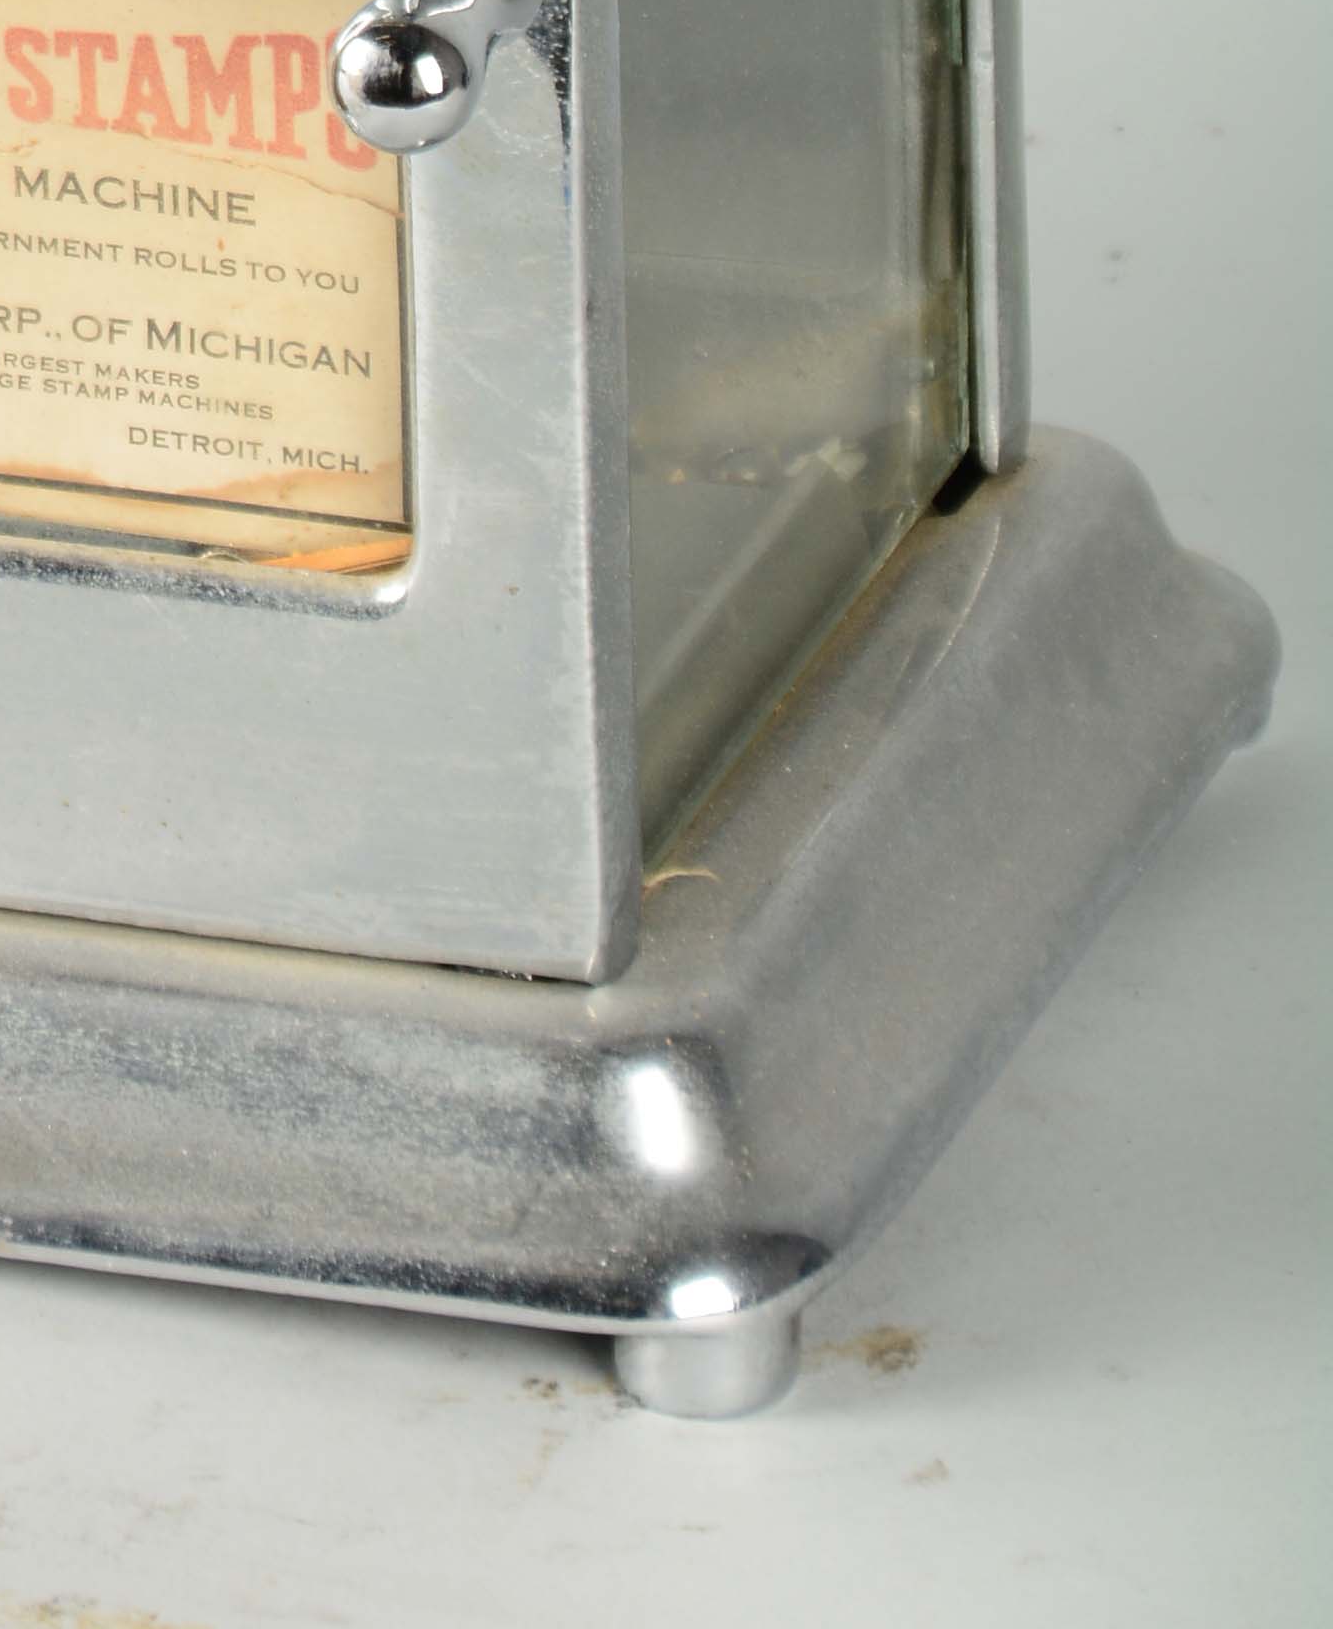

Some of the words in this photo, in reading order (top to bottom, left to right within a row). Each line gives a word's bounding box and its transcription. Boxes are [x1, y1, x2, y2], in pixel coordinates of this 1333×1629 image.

[14, 165, 256, 227] MACHINE
[134, 246, 237, 278] ROLLS
[245, 259, 286, 284] TO
[296, 268, 360, 295] YOU
[71, 314, 133, 345] OF
[147, 317, 372, 379] MICHIGAN
[95, 361, 200, 390] MAKERS
[43, 377, 129, 401] STAMP
[137, 389, 274, 421] MACHINES
[282, 446, 370, 475] MICH.
